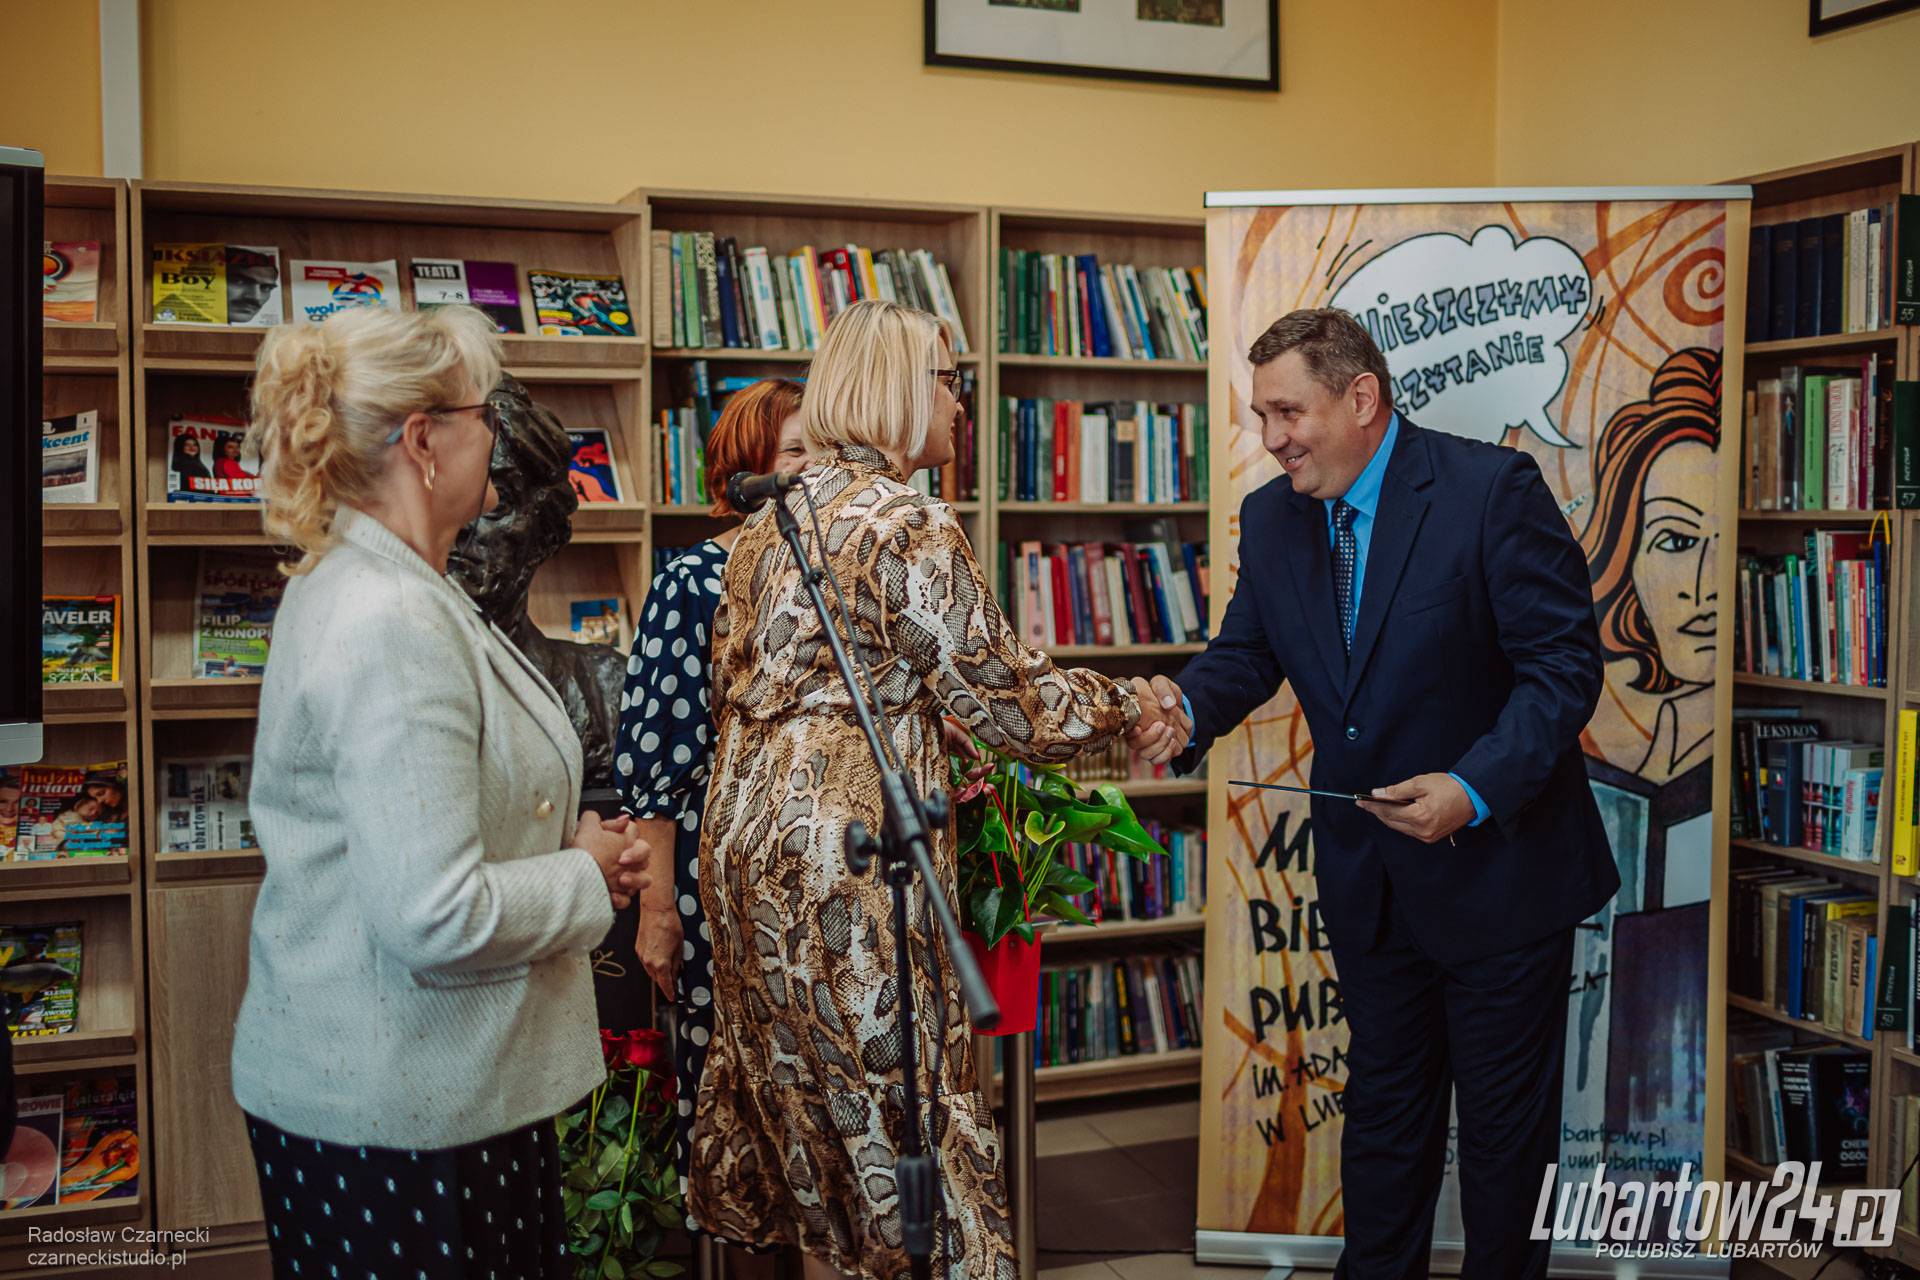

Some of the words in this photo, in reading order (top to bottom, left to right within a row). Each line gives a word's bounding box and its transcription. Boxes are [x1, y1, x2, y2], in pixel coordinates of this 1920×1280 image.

[416, 266, 457, 279] TEATR
[1901, 492, 1916, 506] 57
[43, 610, 111, 625] AVELER
[202, 616, 240, 625] FILIP
[1756, 723, 1819, 738] LEKSYKON
[191, 786, 206, 855] ubartowiak
[1850, 938, 1862, 988] FIZYKA
[16, 1098, 62, 1113] ROWIE
